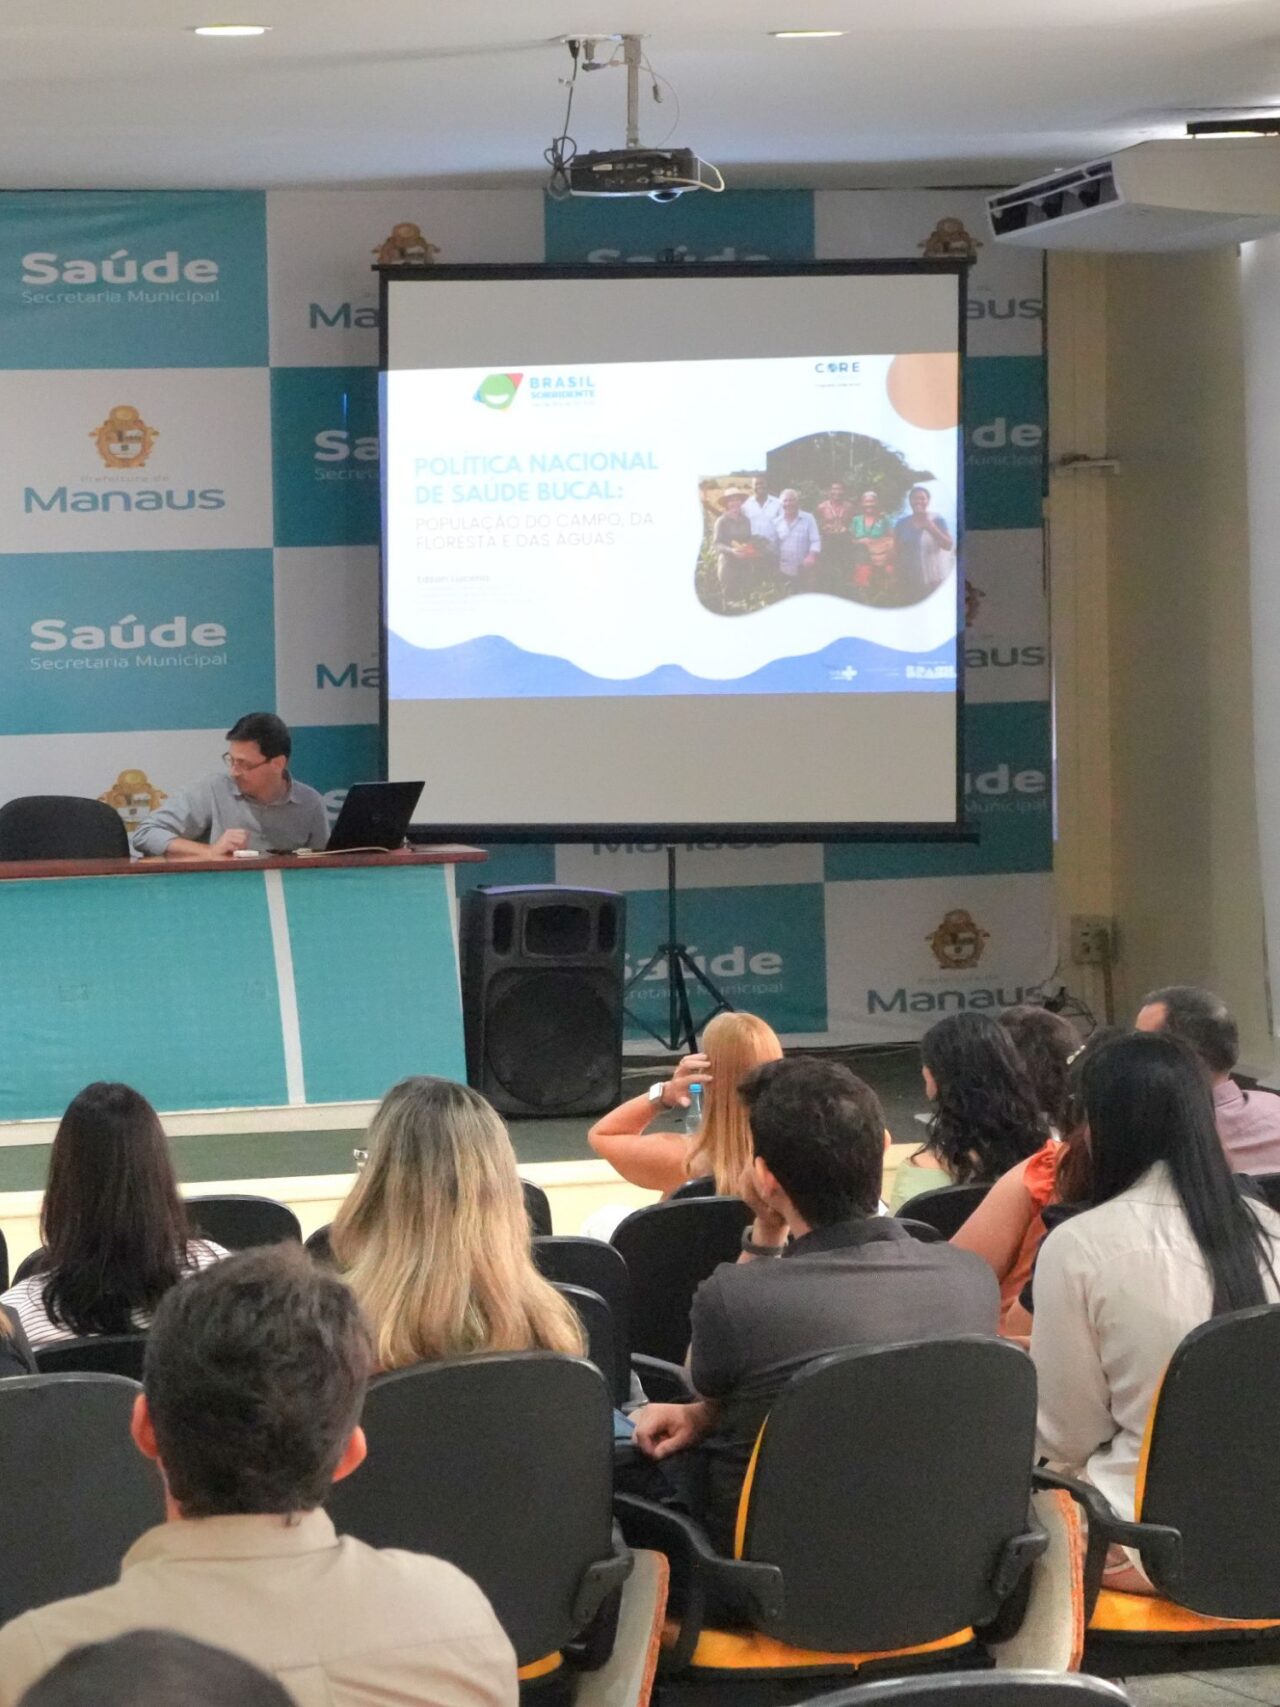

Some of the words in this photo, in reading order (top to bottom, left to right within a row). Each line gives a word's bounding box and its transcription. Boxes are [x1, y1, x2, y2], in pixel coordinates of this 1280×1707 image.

[21, 249, 219, 285] Saúde
[21, 290, 121, 304] Secretaria
[127, 289, 220, 305] Municipal
[966, 298, 1043, 320] aus
[529, 375, 596, 389] BRASIL
[529, 451, 660, 473] NACIONAL
[23, 486, 225, 514] Manaus
[415, 484, 443, 505] DE
[537, 480, 624, 500] BUCAL:
[525, 514, 552, 528] DO
[630, 511, 655, 526] DA
[415, 534, 496, 551] FLORESTA
[502, 534, 510, 548] E
[516, 533, 551, 548] DAS
[30, 614, 227, 651] Saúde
[30, 655, 129, 670] Secretaria
[135, 652, 228, 669] Municipal
[966, 646, 1045, 668] aus
